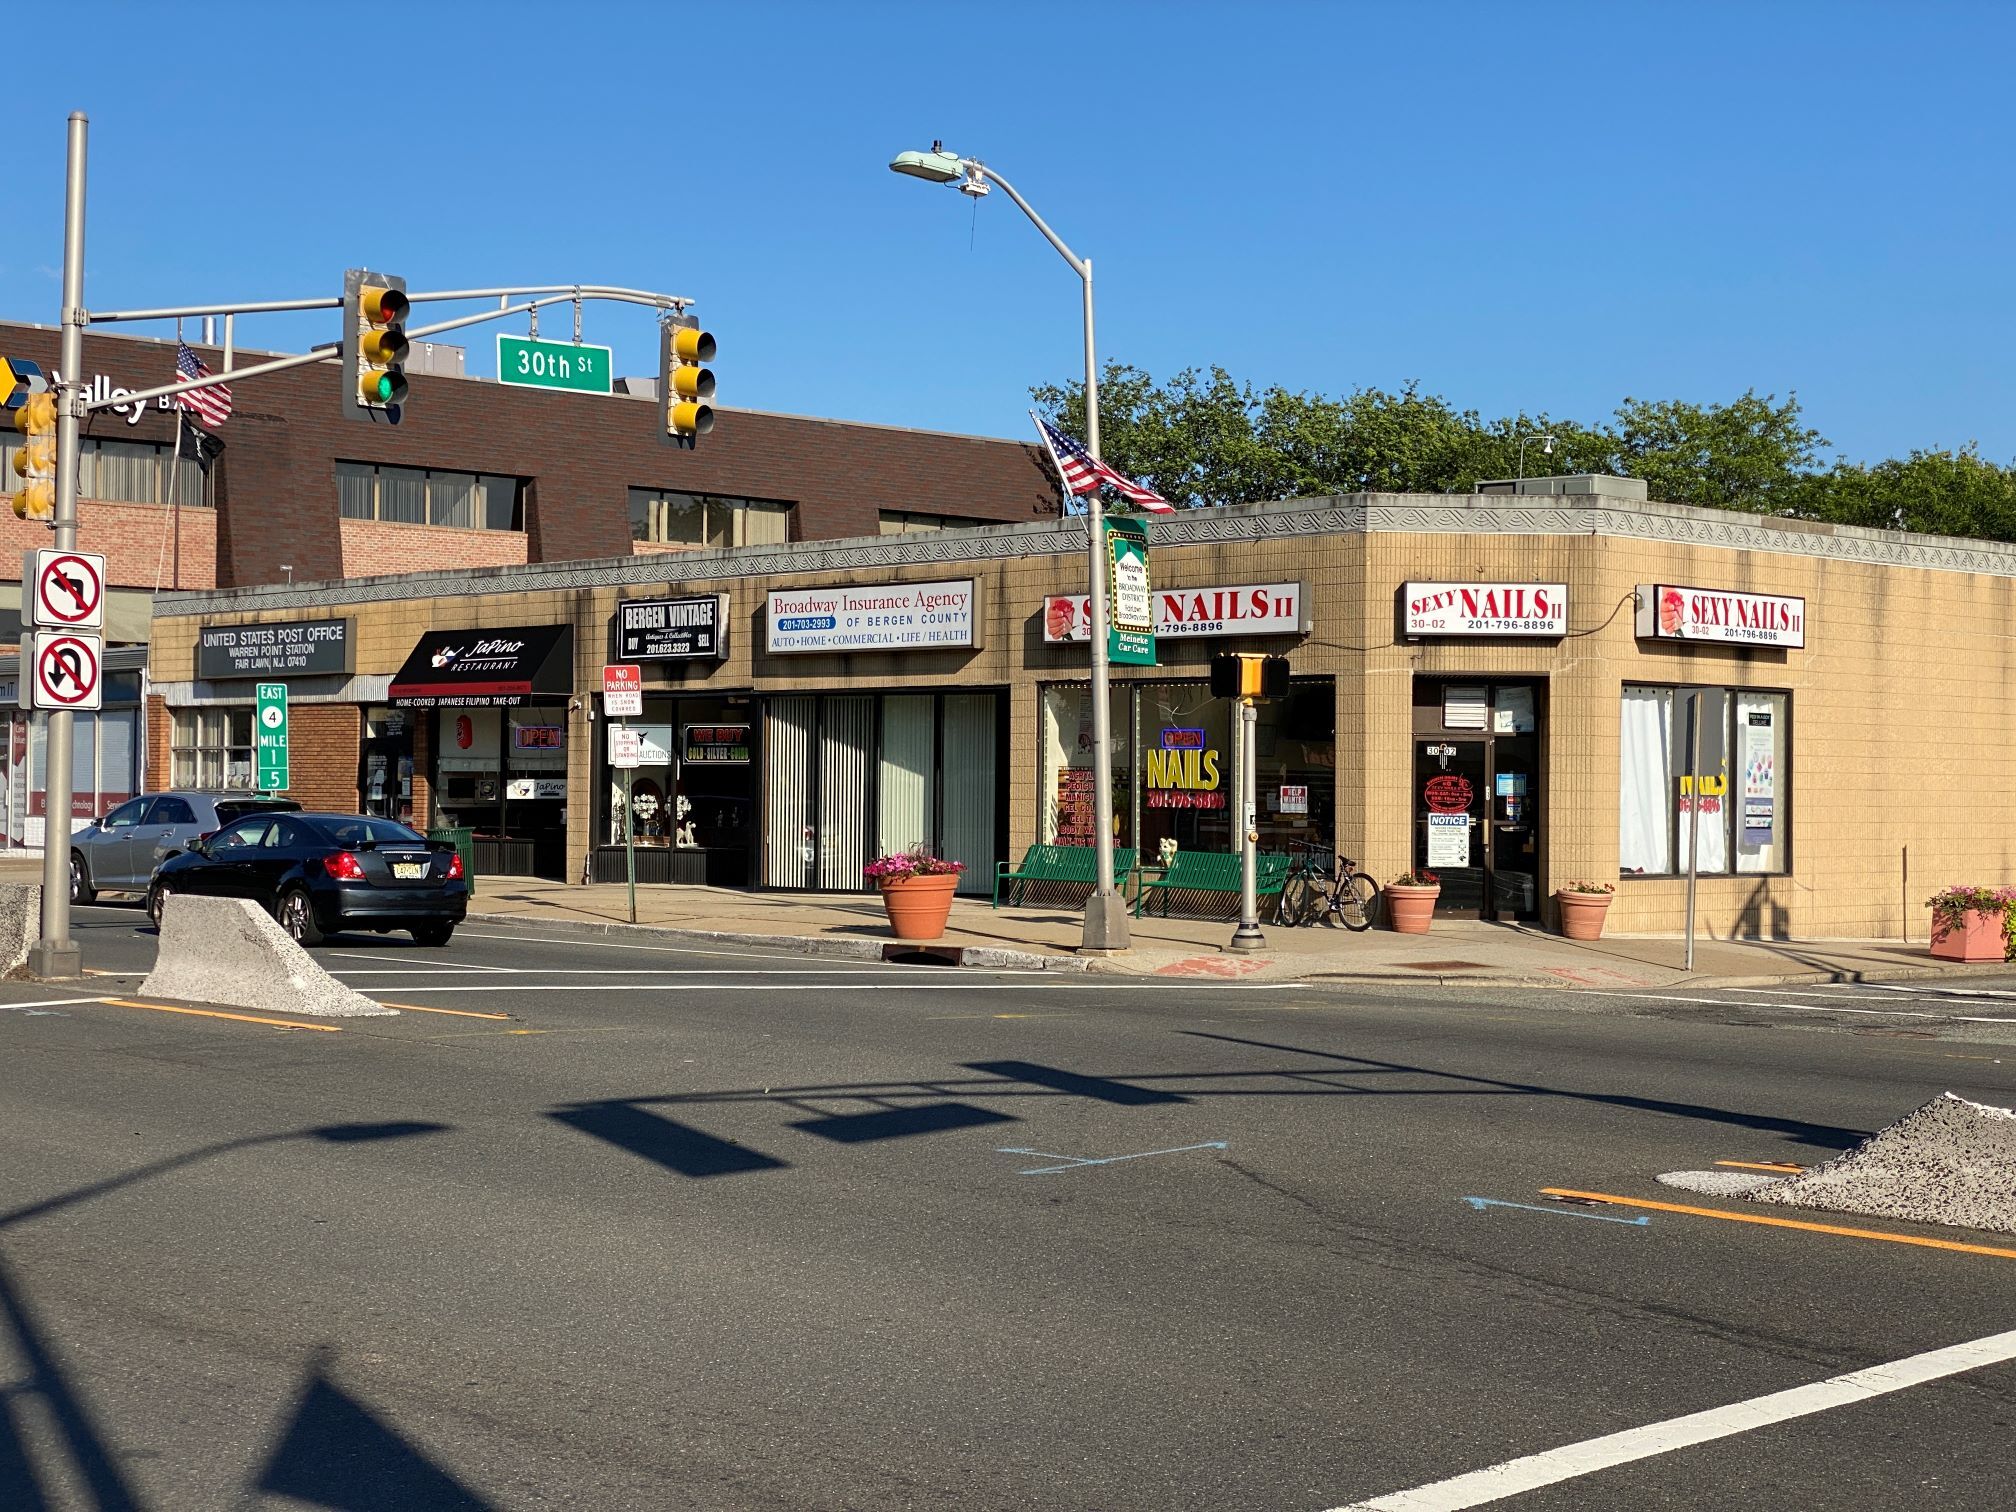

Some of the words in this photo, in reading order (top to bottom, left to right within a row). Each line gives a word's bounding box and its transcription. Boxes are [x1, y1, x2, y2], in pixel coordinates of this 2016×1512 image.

[518, 350, 570, 379] 30th
[578, 357, 593, 373] St
[52, 371, 146, 424] alley
[1119, 562, 1143, 574] Welcome
[1118, 583, 1146, 593] BROADWAY
[1121, 592, 1144, 602] DISTRICT
[773, 597, 838, 617] Broadway
[843, 594, 910, 612] Insurance
[914, 591, 969, 613] Agency
[1162, 589, 1269, 622] NAILS
[1273, 597, 1293, 618] II
[1411, 588, 1457, 617] SEXY
[1459, 588, 1549, 619] NAILS
[1551, 603, 1562, 619] II
[625, 606, 666, 630] BERGEN
[668, 603, 713, 627] VINTAGE
[846, 617, 860, 627] OF
[867, 615, 914, 627] BERGEN
[921, 612, 968, 625] COUNTY
[1691, 594, 1733, 627] SEXY
[1736, 599, 1790, 632] NAILS
[1792, 615, 1800, 633] II
[782, 619, 831, 631] 201-703-2993
[1153, 621, 1223, 634] 1-796-8896
[1411, 619, 1446, 629] 30-02
[1467, 620, 1554, 630] 201-796-8896
[203, 633, 237, 648] UNITED
[240, 630, 275, 645] STATES
[278, 628, 304, 643] POST
[307, 626, 343, 641] OFFICE
[772, 636, 795, 647] AUTO
[800, 635, 827, 646] HOME
[832, 633, 894, 645] COMMERCIAL
[928, 630, 968, 642] HEALTH
[1119, 633, 1149, 645] Meineke
[1691, 625, 1710, 636] 30-02
[1724, 628, 1778, 641] 201-796-8896
[627, 637, 639, 650] BUY
[697, 634, 710, 647] SELL
[229, 646, 259, 658] WARREN
[261, 645, 283, 656] POINT
[285, 643, 315, 655] STATION
[465, 639, 525, 658] JaPino
[646, 642, 690, 654] 201.623.3323
[1118, 643, 1132, 652] Car
[1132, 644, 1149, 654] Care
[235, 659, 249, 669] FAIR
[273, 657, 285, 668] N.J.
[287, 656, 307, 667] 07410
[450, 661, 518, 672] RESTAURANT
[615, 669, 628, 679] NO
[606, 681, 638, 691] PARKING
[261, 686, 282, 700] EAST
[396, 697, 436, 707] HOME-COOKED
[437, 697, 465, 706] JAPANESE
[466, 697, 490, 706] FILIPINO
[492, 696, 521, 705] TAKE-OUT
[269, 711, 276, 723] 4
[260, 735, 286, 747] MILE
[519, 729, 559, 746] OPEN
[693, 728, 714, 742] WE
[716, 728, 744, 742] BUY
[1164, 731, 1202, 746] OPEN
[271, 749, 276, 765] 1
[638, 750, 671, 759] AUCTIONS
[1428, 747, 1439, 755] 30
[1069, 771, 1094, 780] ACRYL
[1147, 749, 1220, 791] NAILS
[267, 771, 280, 787] .5
[534, 783, 565, 792] JaPino
[1066, 782, 1094, 791] PEDICU
[1287, 788, 1302, 797] HELP
[1065, 792, 1095, 802] MANICU
[1283, 796, 1305, 804] WANTED
[1064, 804, 1077, 813] GEL
[1080, 803, 1094, 812] COL
[1070, 815, 1084, 824] GEL
[1431, 815, 1467, 825] NOTICE
[1060, 826, 1080, 834] BODY
[1084, 826, 1096, 834] WA
